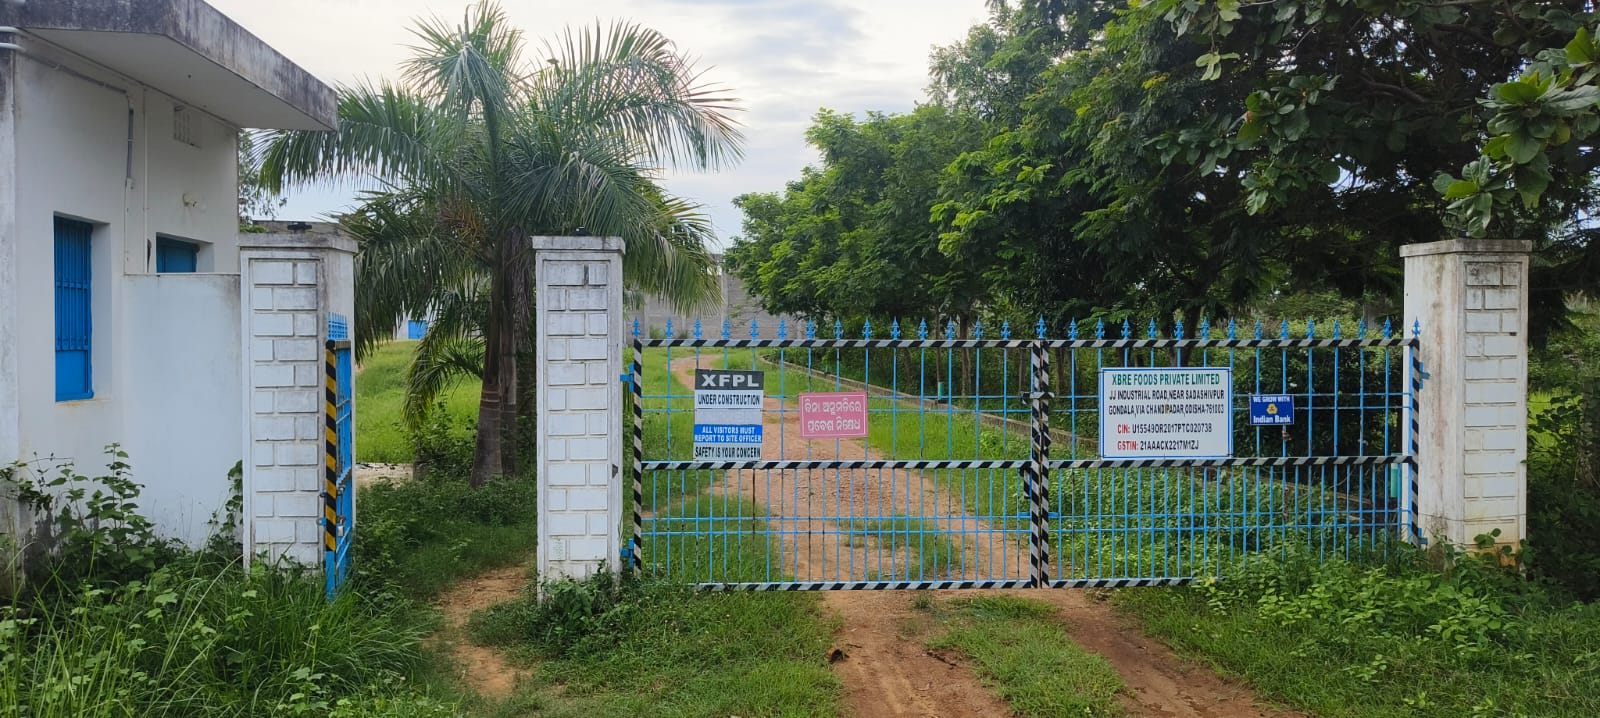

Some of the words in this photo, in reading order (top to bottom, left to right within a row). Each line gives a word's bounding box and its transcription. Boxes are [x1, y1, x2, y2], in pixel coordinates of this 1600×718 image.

[701, 374, 760, 387] XFPL
[1112, 374, 1132, 385] XBRE
[1133, 374, 1158, 385] FOODS
[1160, 374, 1190, 385] PRIVATE
[1191, 373, 1220, 385] LIMITED
[698, 394, 717, 405] UNDER
[718, 394, 760, 406] CONSTRUCTION
[1109, 390, 1117, 400] JJ
[1117, 390, 1151, 400] INDUSTRIAL
[1185, 390, 1225, 400] SADASHIVPUR
[1253, 415, 1274, 423] Indian
[1274, 415, 1291, 423] Bank
[702, 426, 712, 434] ALL
[740, 427, 755, 435] MUST
[1117, 424, 1131, 434] CIN:
[694, 434, 716, 442] REPORT
[739, 435, 762, 443] OFFICER
[1117, 441, 1139, 451] GSTIN:
[695, 446, 714, 457] SAFETY
[715, 448, 721, 457] IS
[722, 448, 735, 458] YOUR
[736, 448, 761, 458] CONCERN
